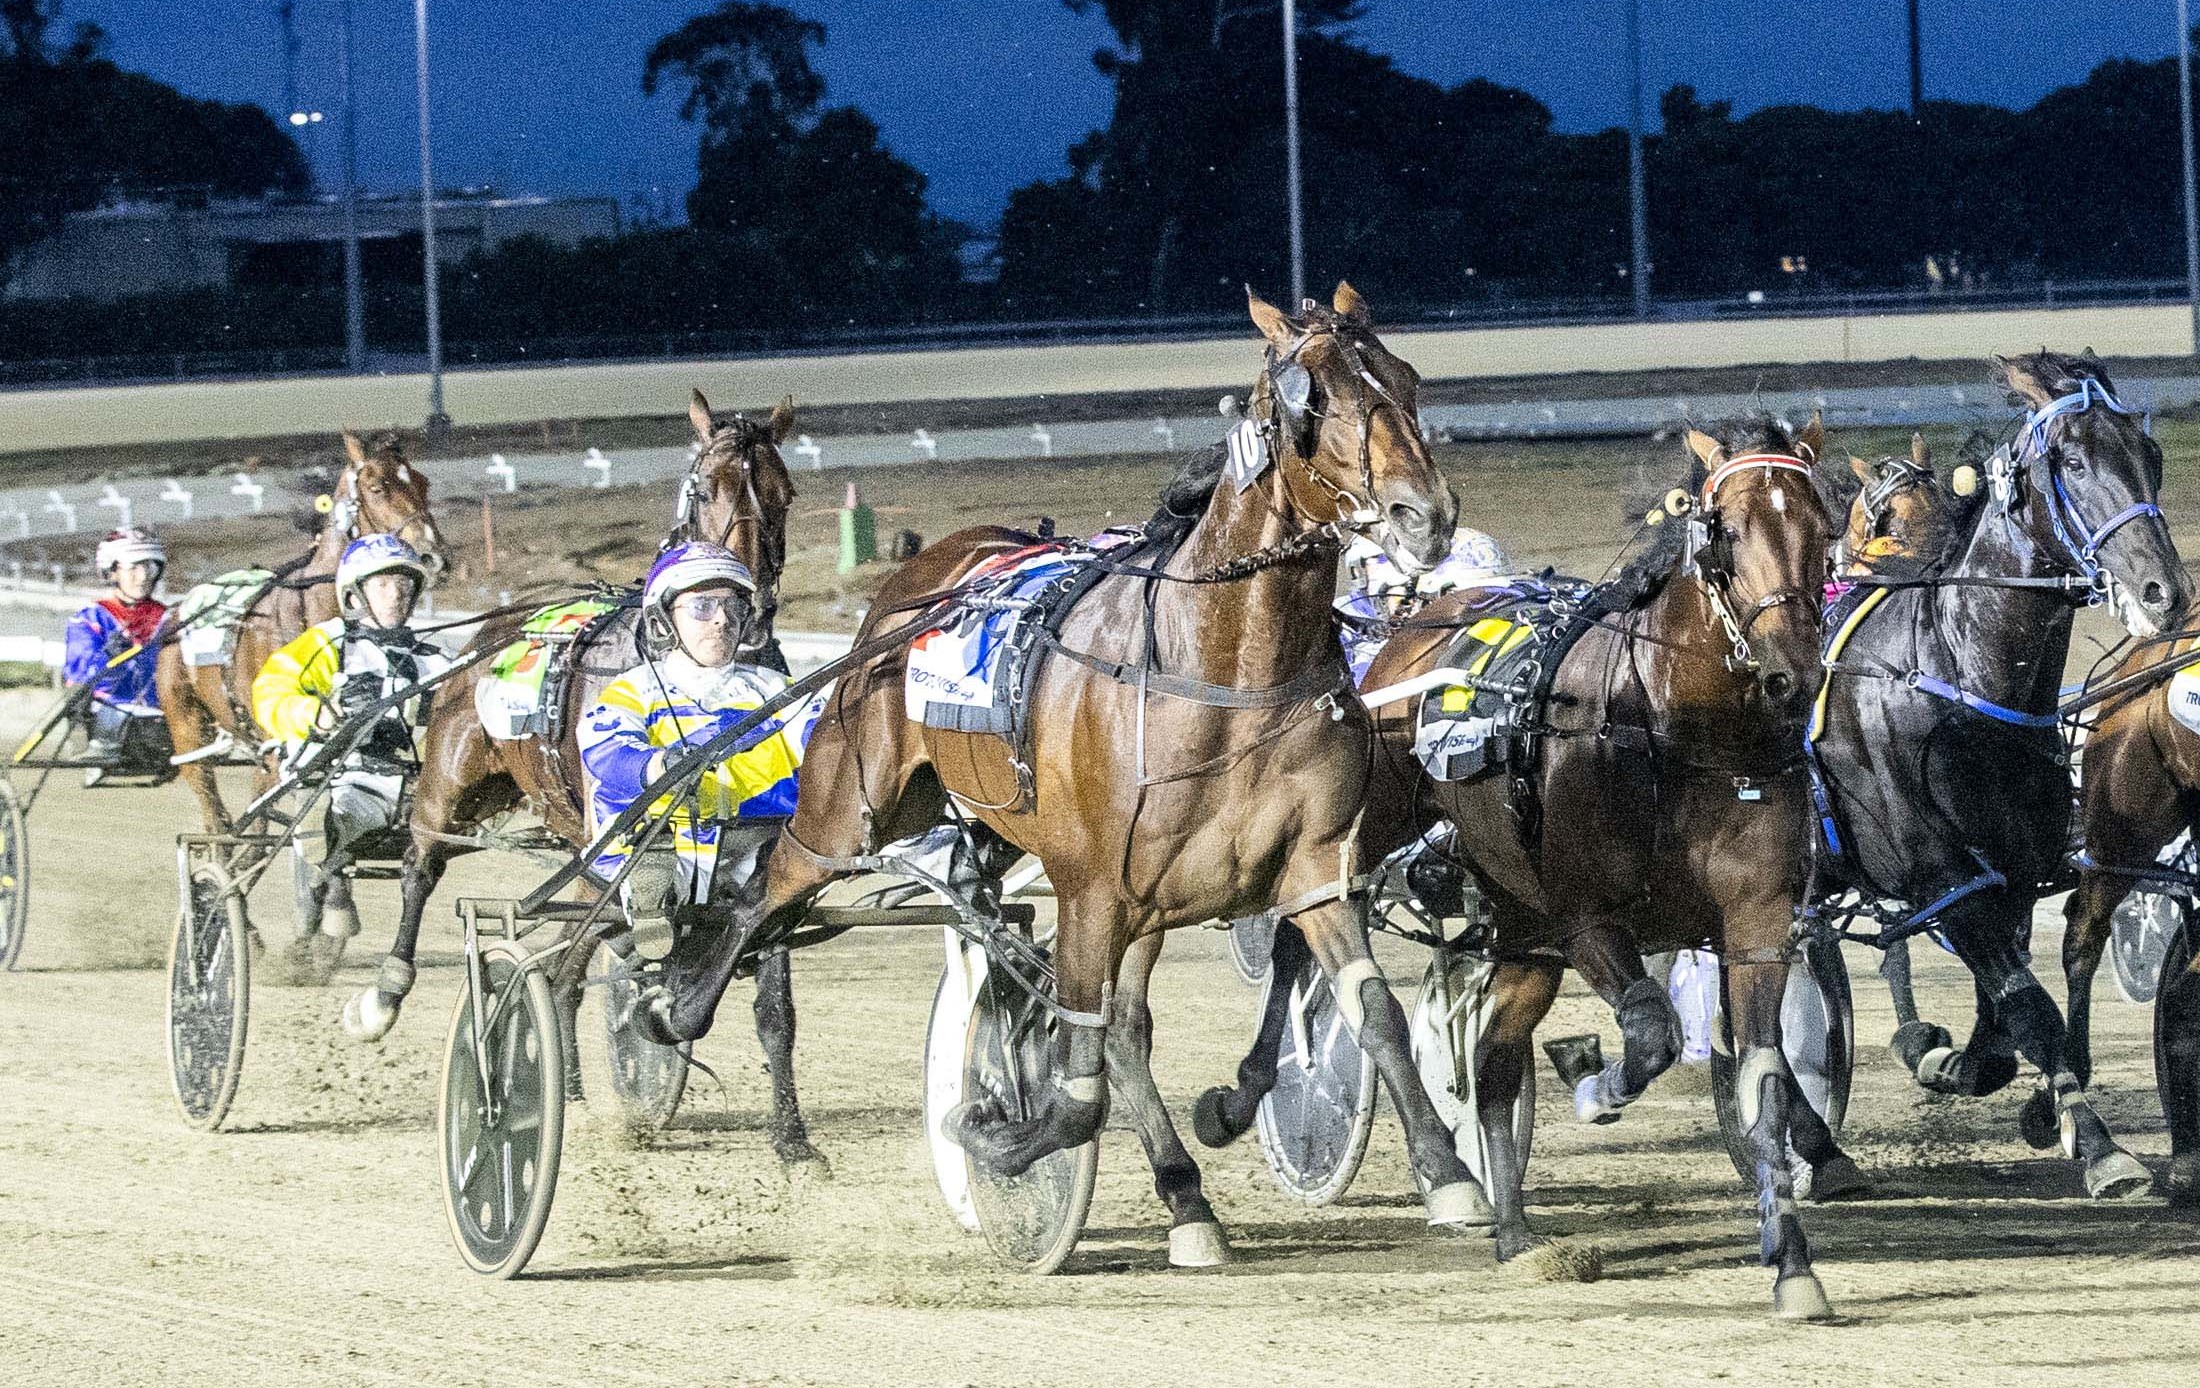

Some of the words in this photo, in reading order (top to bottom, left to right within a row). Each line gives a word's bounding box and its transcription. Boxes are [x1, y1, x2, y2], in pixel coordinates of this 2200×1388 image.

[1231, 419, 1259, 481] 10
[1992, 457, 2007, 501] 8
[2186, 691, 2200, 706] TR
